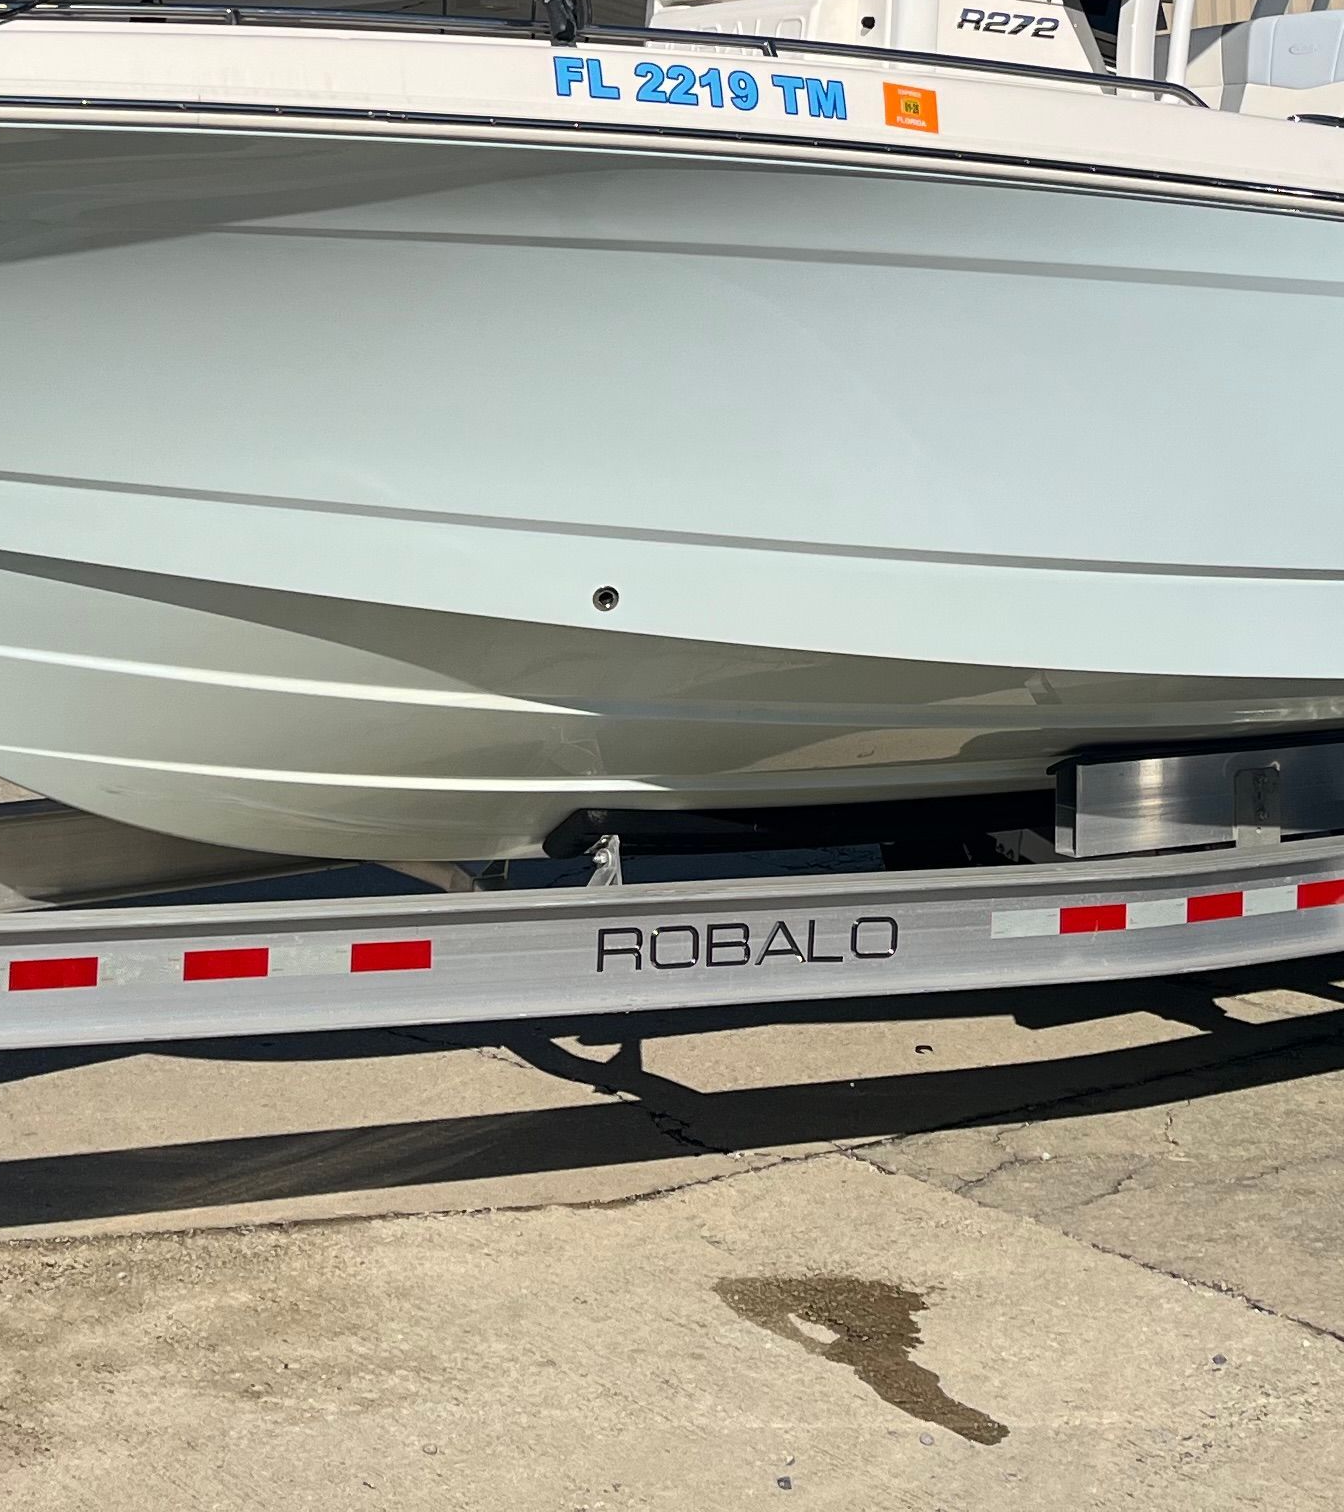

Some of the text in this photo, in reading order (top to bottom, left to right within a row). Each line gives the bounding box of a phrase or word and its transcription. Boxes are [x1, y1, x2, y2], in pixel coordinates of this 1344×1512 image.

[957, 7, 1060, 39] R272
[553, 56, 848, 120] FL 2219 TM
[596, 916, 899, 973] ROBALO
